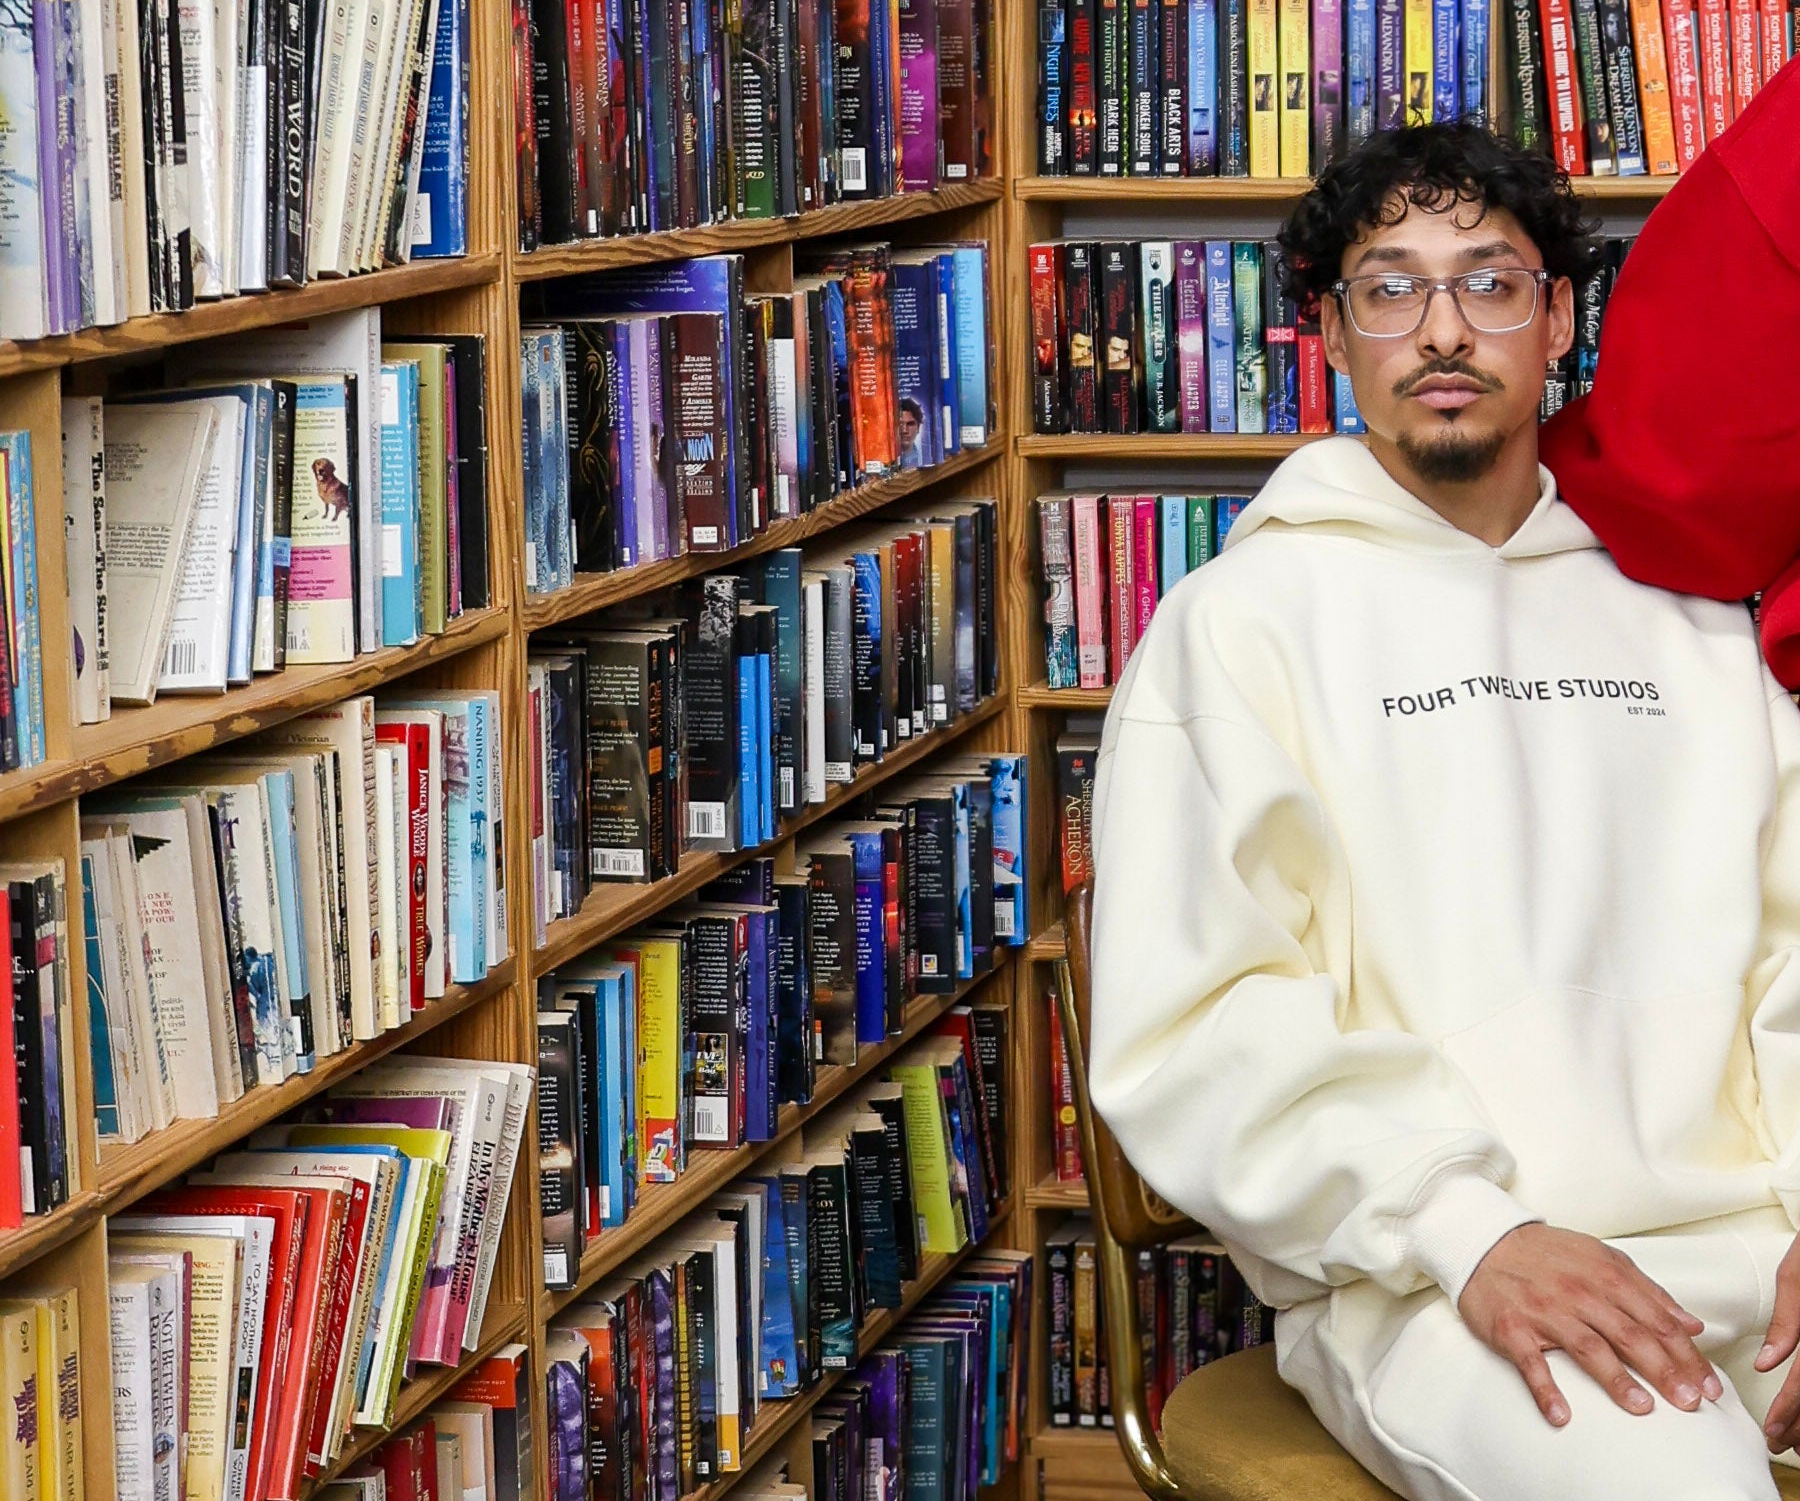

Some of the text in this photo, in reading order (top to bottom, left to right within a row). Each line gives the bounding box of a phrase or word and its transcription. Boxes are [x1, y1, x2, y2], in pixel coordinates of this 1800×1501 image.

[1107, 97, 1119, 153] DARK HEIR
[1139, 91, 1152, 157] BROKEN SOUL
[1168, 88, 1181, 156] BLACK ARTS
[1186, 360, 1197, 385] ELLE
[1382, 675, 1660, 717] FOUR TWELVE STUDIOS
[1627, 706, 1644, 716] EST
[475, 705, 484, 770] NANNING
